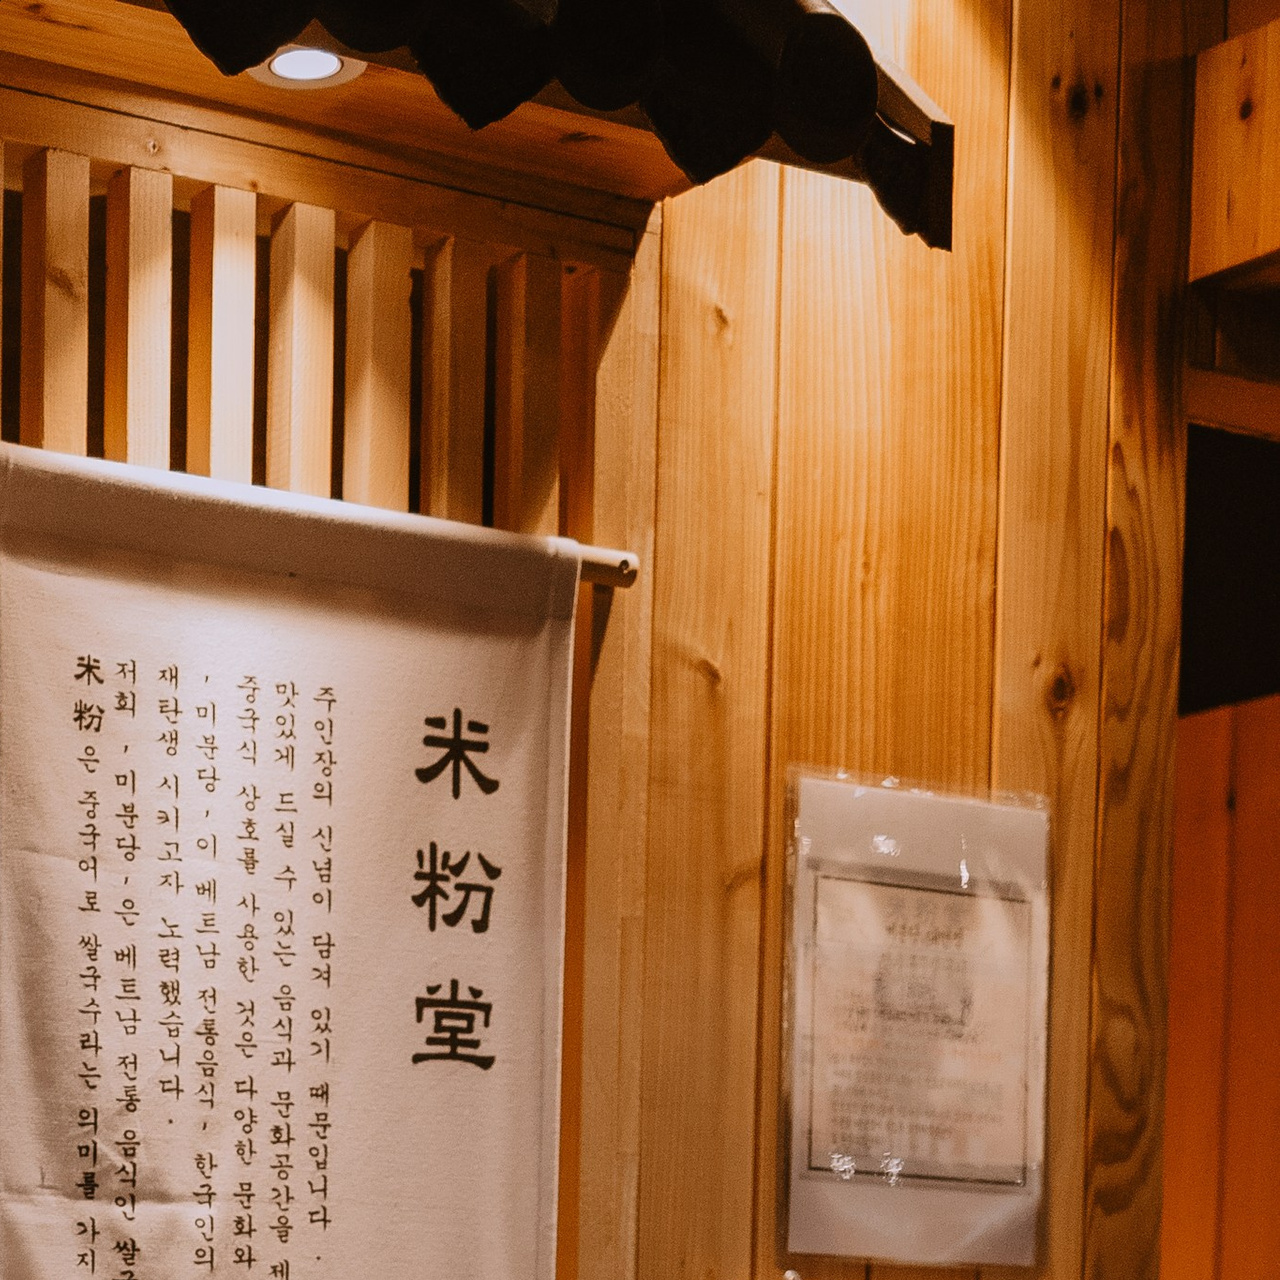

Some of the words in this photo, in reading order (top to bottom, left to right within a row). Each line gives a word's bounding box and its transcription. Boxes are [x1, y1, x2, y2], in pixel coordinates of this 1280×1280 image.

[157, 663, 184, 758] 재탄생
[236, 674, 261, 766] 중국식
[274, 679, 300, 771] 맛있게
[311, 685, 338, 807] 주인장의
[76, 788, 102, 914] 중국어로
[156, 772, 186, 896] 시키고자
[236, 782, 262, 877] 상호를
[273, 790, 299, 850] 드실
[273, 863, 299, 891] 수
[311, 823, 334, 914] 신념이
[410, 707, 503, 1072] 米粉堂
[194, 876, 222, 970] 베트남
[235, 890, 262, 984] 사용한
[271, 907, 298, 967] 있는
[311, 930, 337, 990] 담겨
[76, 931, 104, 1092] 쌀국수라는
[112, 941, 143, 1037] 베트남
[233, 997, 259, 1060] 것은
[269, 982, 298, 1074] 음식과
[309, 1004, 334, 1065] 있기
[74, 1104, 101, 1202] 의미를
[232, 1073, 259, 1167] 다양한
[267, 1088, 297, 1245] 문화공간을
[191, 1150, 219, 1275] 한국인의
[231, 1179, 259, 1272] 문화와
